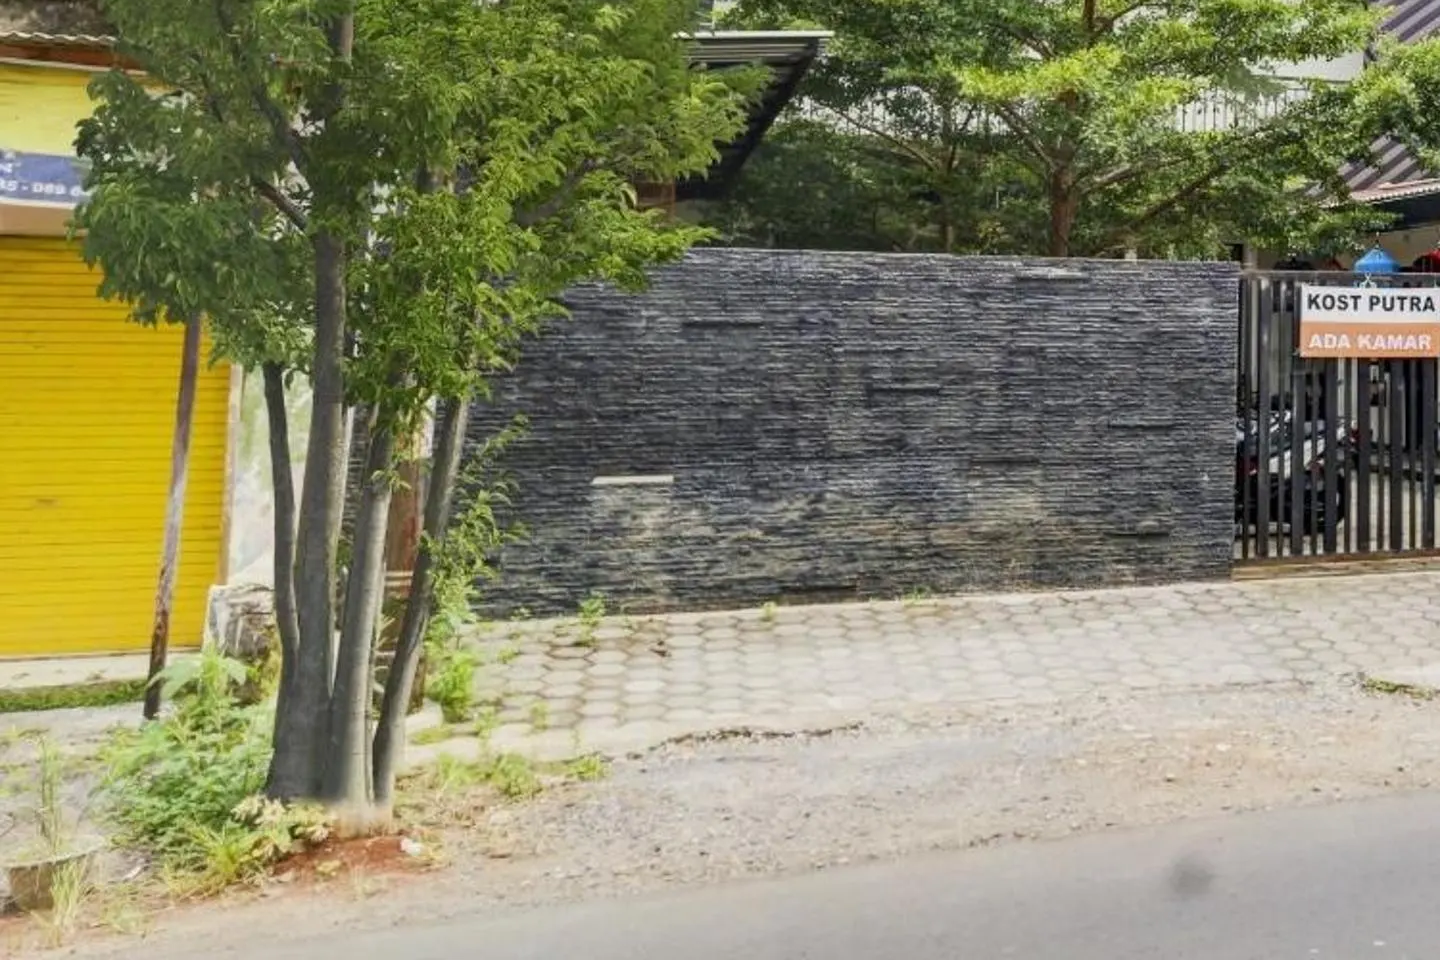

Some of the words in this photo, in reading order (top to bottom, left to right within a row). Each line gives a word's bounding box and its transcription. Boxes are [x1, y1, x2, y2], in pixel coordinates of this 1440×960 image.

[1307, 294, 1361, 310] KOST
[1368, 295, 1435, 312] PUTRA
[1308, 333, 1351, 349] ADA
[1356, 334, 1432, 350] KAMAR
